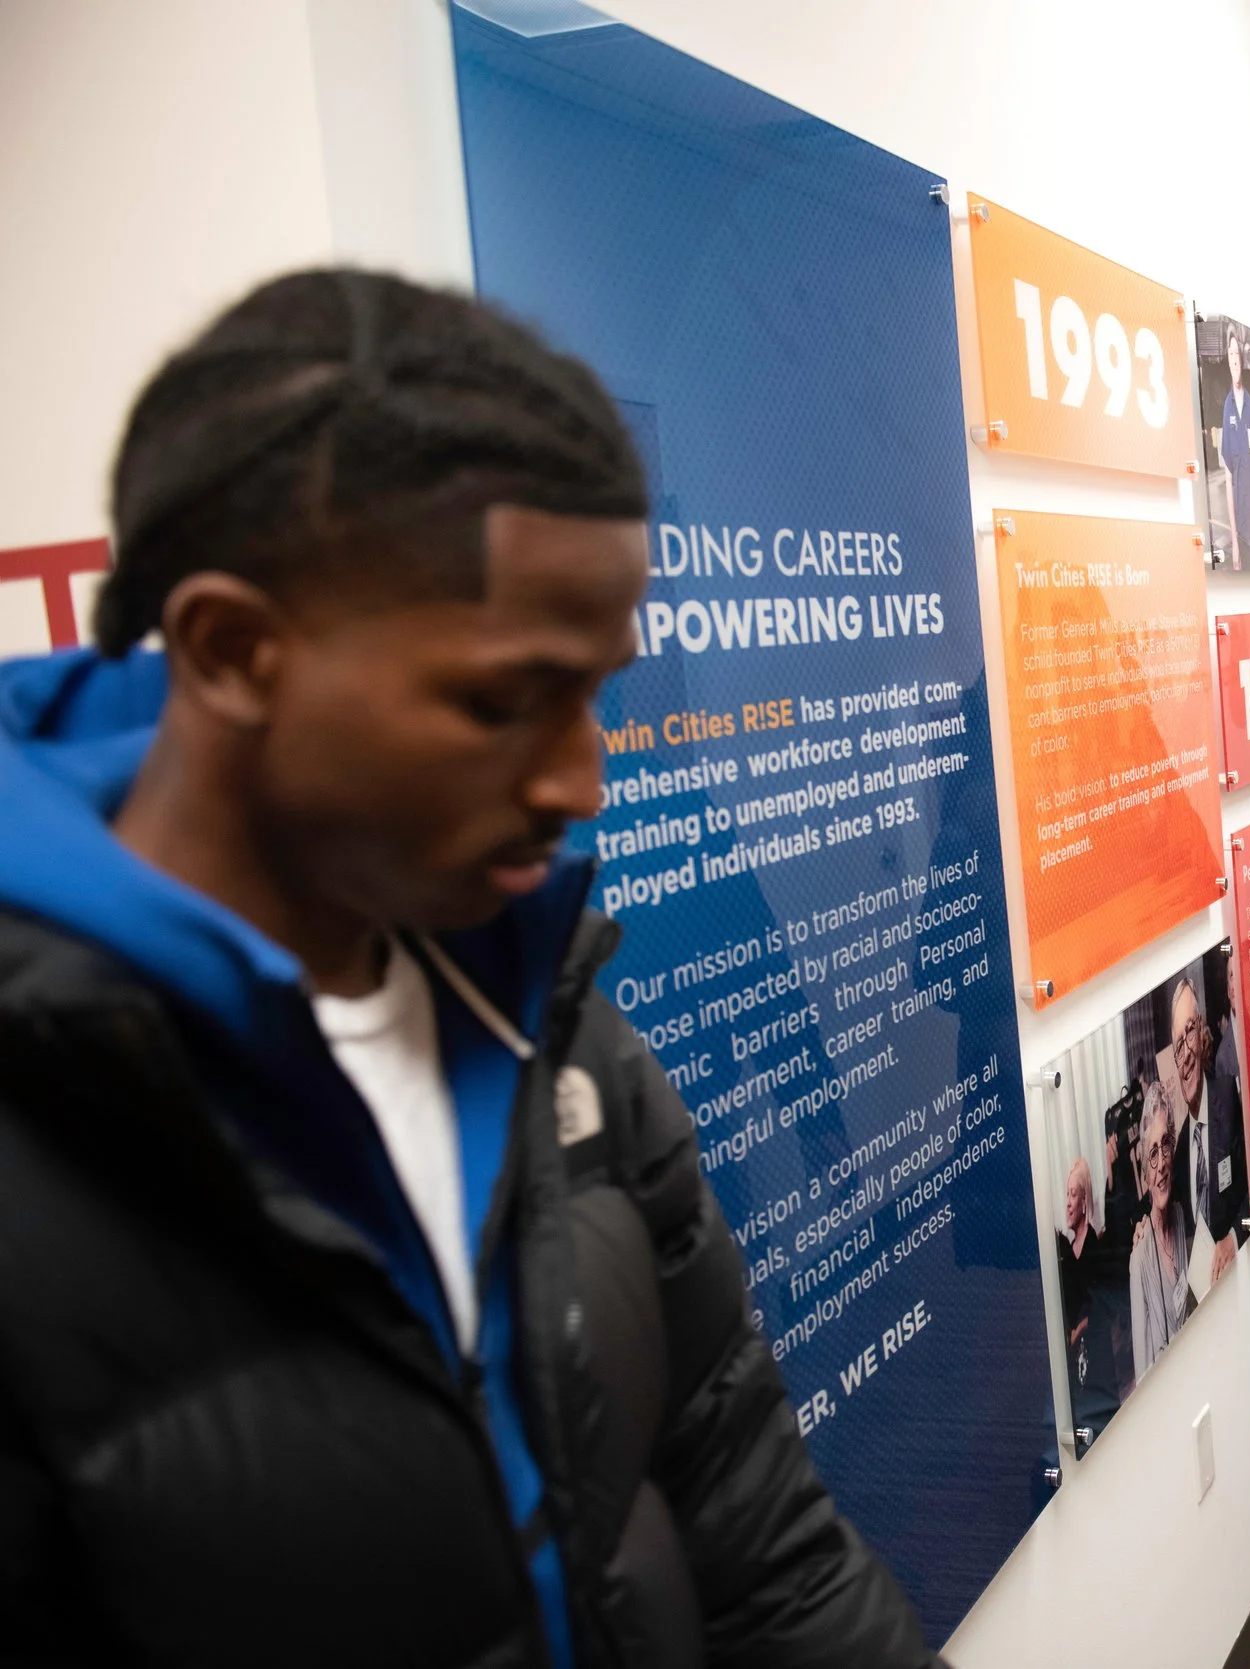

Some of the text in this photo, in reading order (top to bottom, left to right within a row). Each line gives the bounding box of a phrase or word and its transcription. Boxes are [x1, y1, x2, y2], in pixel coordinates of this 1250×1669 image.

[1013, 276, 1169, 429] 1993
[649, 523, 903, 577] DING CAREERS
[1014, 560, 1048, 588] Twin
[1050, 561, 1085, 587] Cities
[1114, 562, 1123, 586] is
[1125, 563, 1150, 586] Born
[633, 592, 944, 657] POWERING LIVES
[1019, 621, 1058, 641] Former
[1061, 617, 1097, 638] General
[1099, 616, 1117, 634] Mills
[1054, 644, 1092, 667] founded
[1092, 643, 1113, 661] Twin
[1114, 640, 1137, 658] Cities
[1156, 640, 1164, 652] as
[1165, 640, 1169, 651] a
[598, 681, 963, 755] win Cities R!SE has provided com-
[1024, 675, 1070, 702] nonprofit
[1071, 675, 1082, 691] to
[1083, 673, 1106, 690] serve
[1107, 665, 1149, 685] individuals
[1027, 709, 1050, 729] cant
[1051, 699, 1086, 723] barriers
[1088, 699, 1098, 715] to
[1189, 680, 1202, 693] men
[747, 738, 852, 778] workforce
[860, 712, 966, 754] development
[1029, 731, 1069, 757] of color.
[1035, 742, 1207, 814] His bold vision: to reduce poverty through
[596, 752, 970, 862] training to unemployed and underem-
[1036, 764, 1209, 846] long-term career training and employment
[603, 796, 920, 919] ployed individuals since 1993.
[1038, 832, 1093, 875] placement.
[616, 849, 980, 1012] Our mission is to transform the lives of
[633, 892, 982, 1050] hose impacted by racial and socioeco-
[666, 918, 986, 1091] mic barriers through Personal
[686, 952, 989, 1131] owerment, career training, and
[697, 1043, 900, 1173] ningful employment.
[730, 1053, 999, 1247] vision a community where all
[790, 1125, 1006, 1303] financial independence
[795, 1173, 885, 1253] especially
[890, 1133, 944, 1191] people
[947, 1113, 963, 1144] of
[965, 1093, 1002, 1131] color,
[772, 1203, 956, 1362] employment success.
[796, 1299, 933, 1439] ER, WE RISE.
